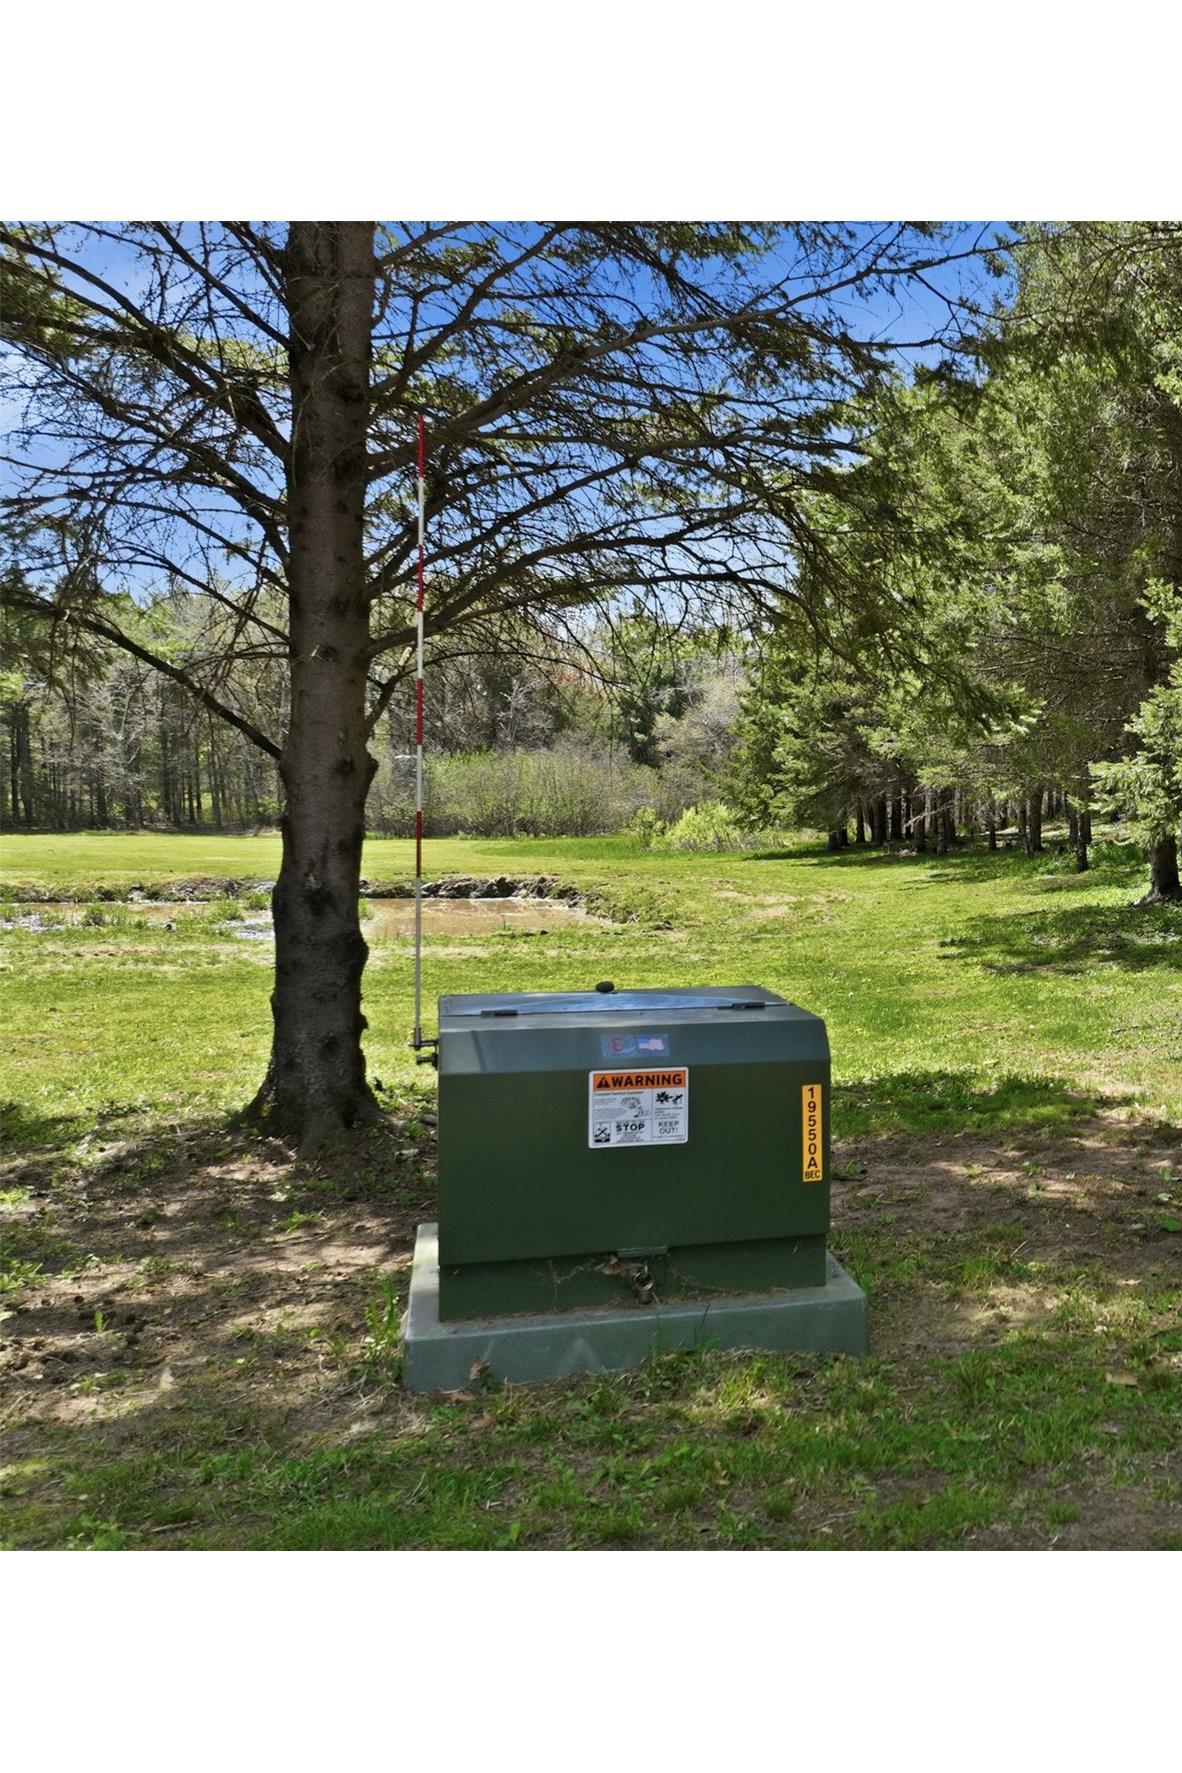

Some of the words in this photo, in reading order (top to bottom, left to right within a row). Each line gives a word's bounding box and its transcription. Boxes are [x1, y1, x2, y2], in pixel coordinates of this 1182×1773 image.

[612, 1074, 682, 1087] WARNING
[616, 1123, 645, 1132] STOP
[807, 1087, 818, 1169] 19550A
[804, 1170, 821, 1180] BEC
